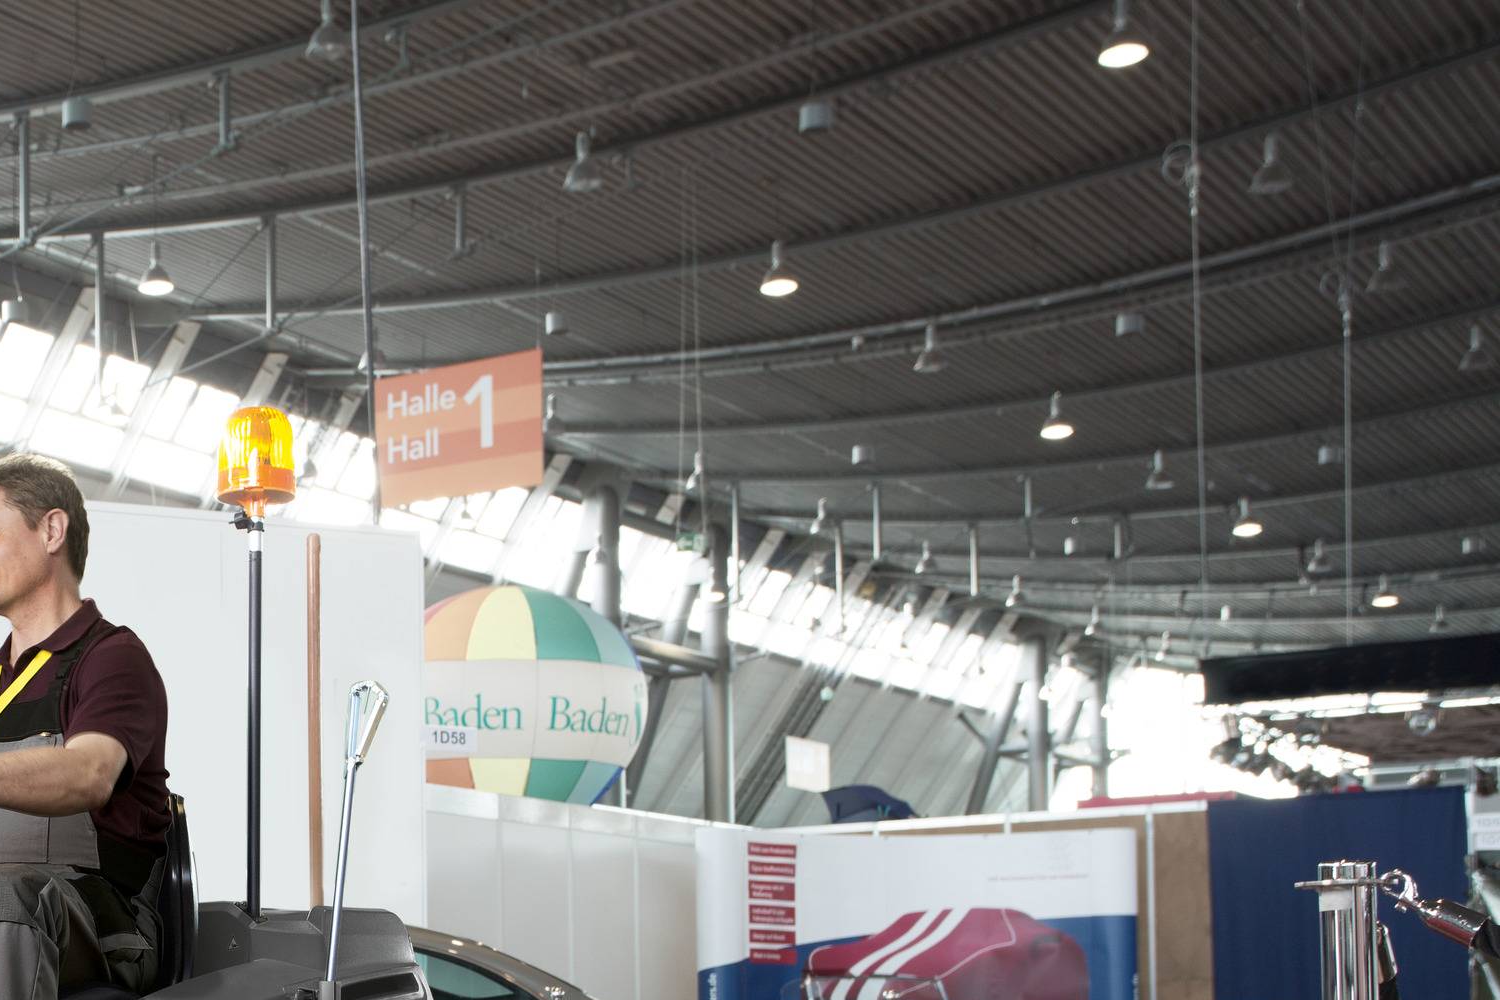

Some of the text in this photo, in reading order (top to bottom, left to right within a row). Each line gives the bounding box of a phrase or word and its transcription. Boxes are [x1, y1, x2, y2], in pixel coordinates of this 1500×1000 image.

[387, 374, 493, 449] Halle 1
[387, 427, 439, 464] Hall
[424, 694, 524, 731] Baden
[547, 695, 630, 738] Baden
[432, 730, 466, 745] 1D58
